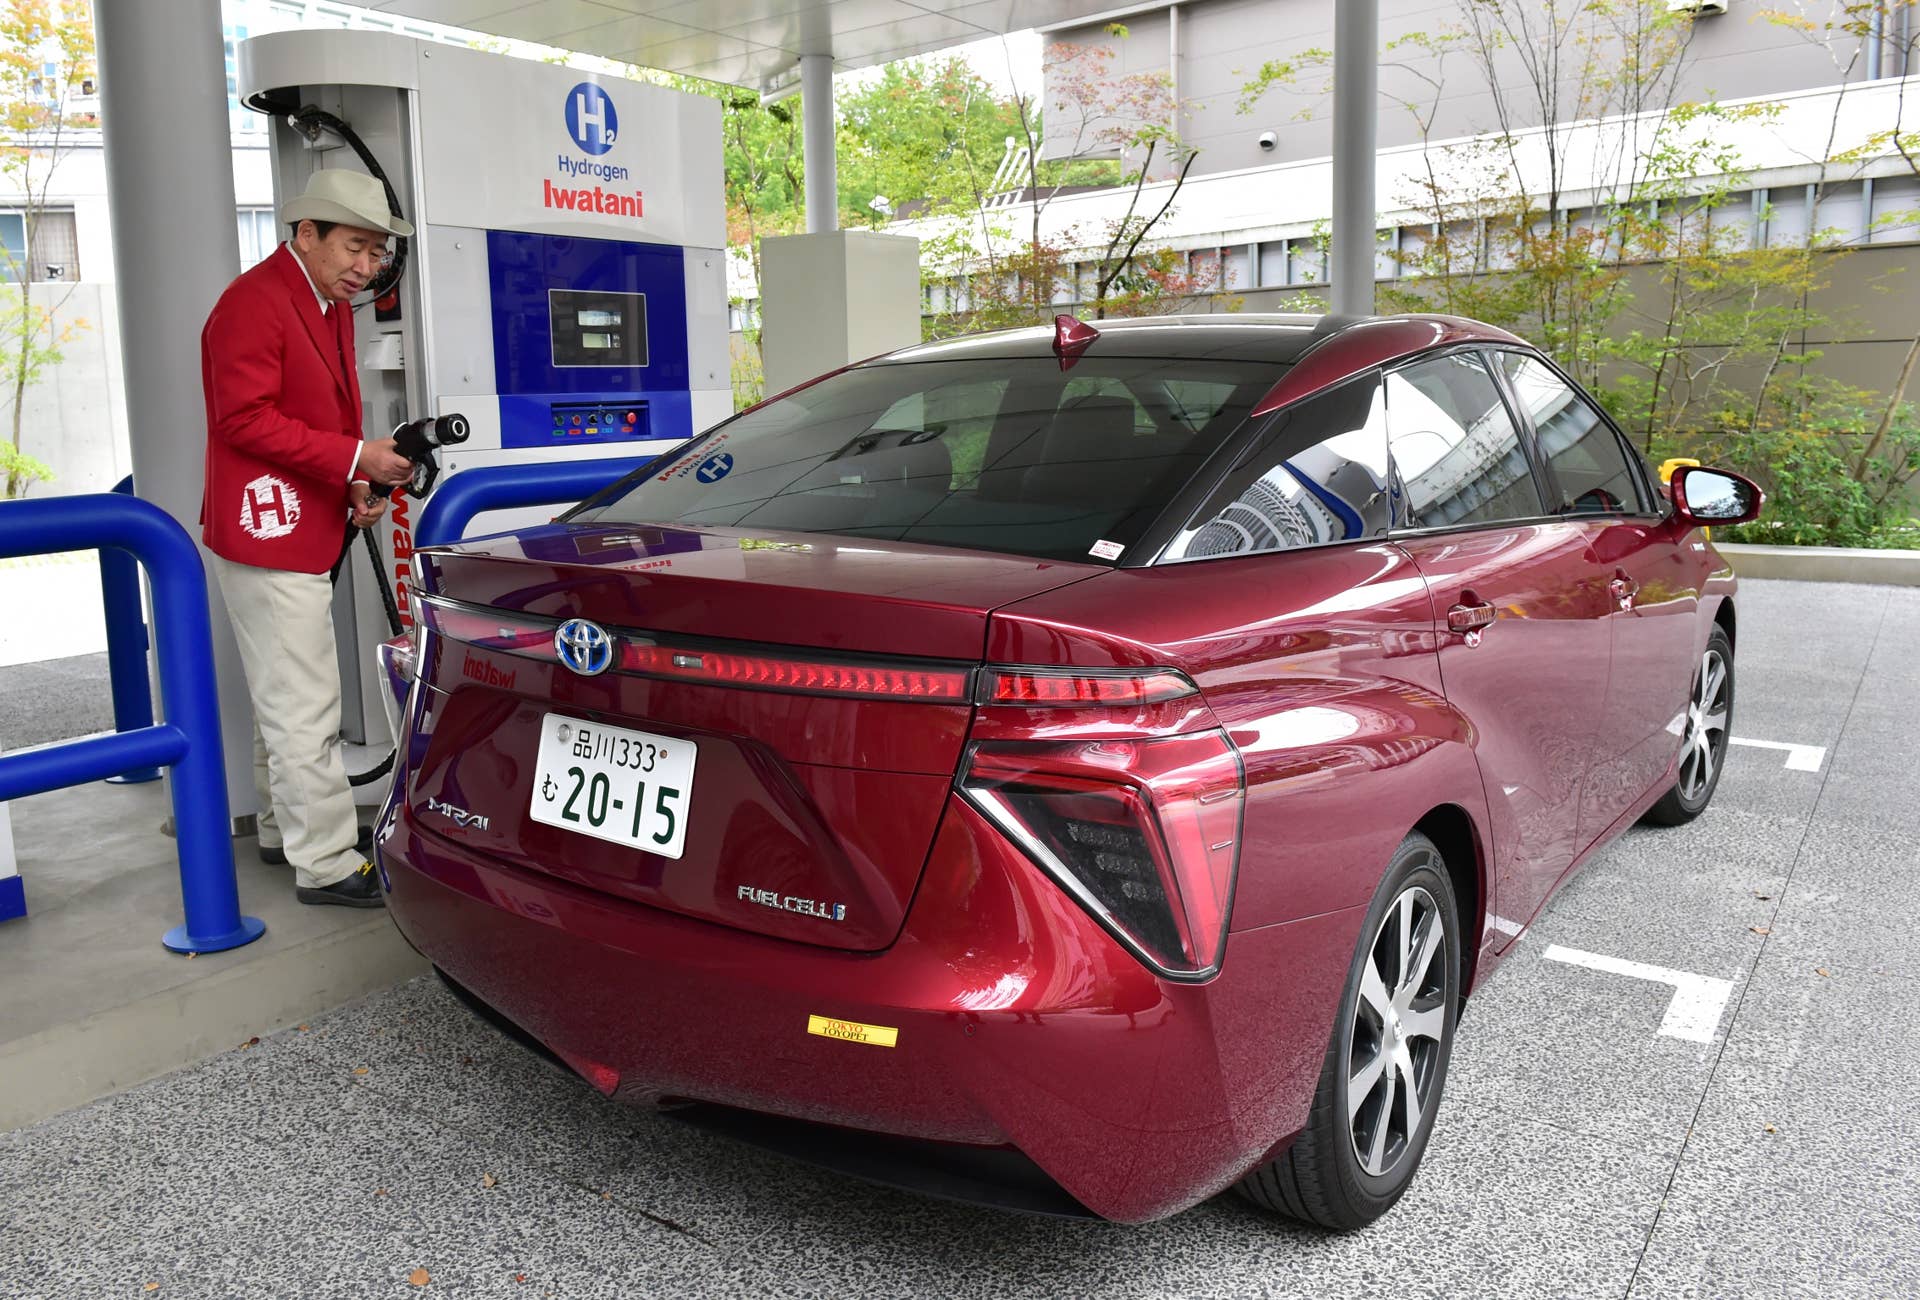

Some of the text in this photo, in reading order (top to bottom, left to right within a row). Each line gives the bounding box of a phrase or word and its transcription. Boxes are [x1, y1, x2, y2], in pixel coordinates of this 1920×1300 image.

[558, 155, 628, 182] Hydrogen
[544, 179, 643, 218] Iwatani
[247, 485, 298, 530] H2
[428, 796, 489, 831] MIRAI
[542, 766, 680, 845] む 20-15
[823, 1027, 867, 1041] TOYOPET
[826, 1019, 863, 1033] TOKYO
